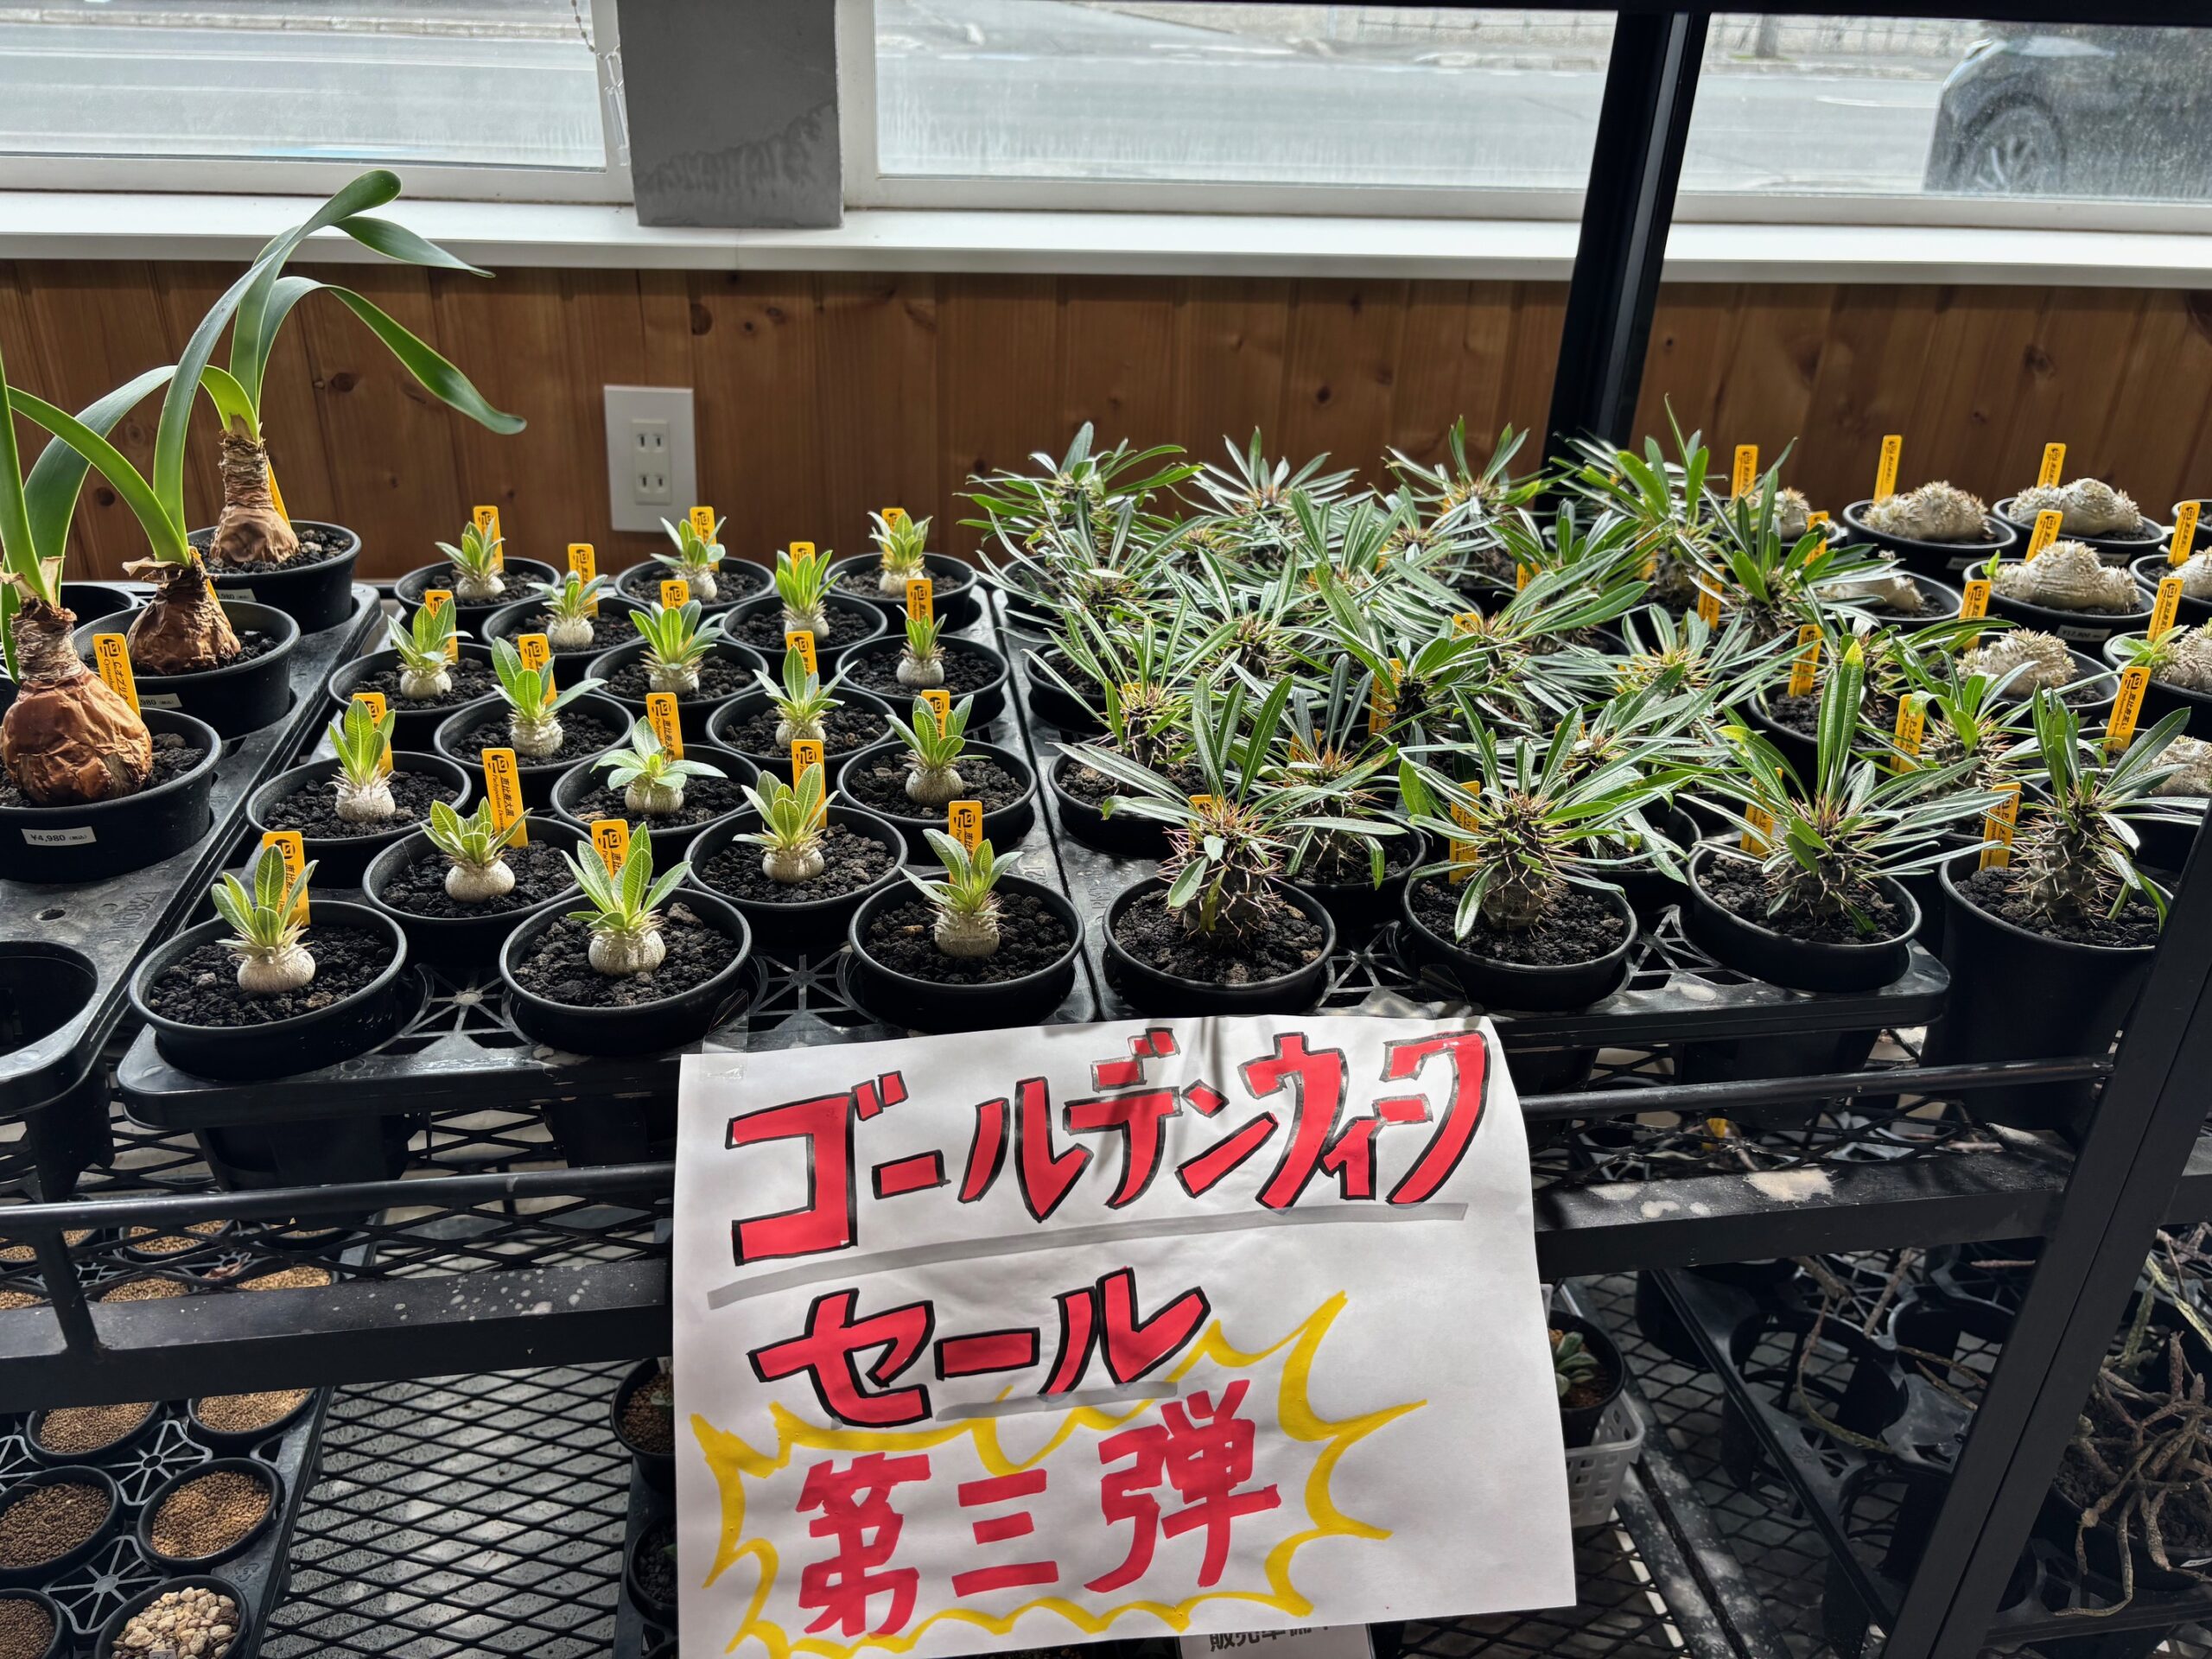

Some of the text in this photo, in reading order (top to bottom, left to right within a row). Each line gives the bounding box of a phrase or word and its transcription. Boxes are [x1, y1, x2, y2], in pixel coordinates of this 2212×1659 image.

[30, 834, 66, 842] ¥4,980
[501, 778, 516, 817] 恵比寿大黒
[726, 1027, 1491, 1265] ゴールデンウィーク
[749, 1266, 1211, 1427] セール
[798, 1379, 1281, 1636] 第三弾
